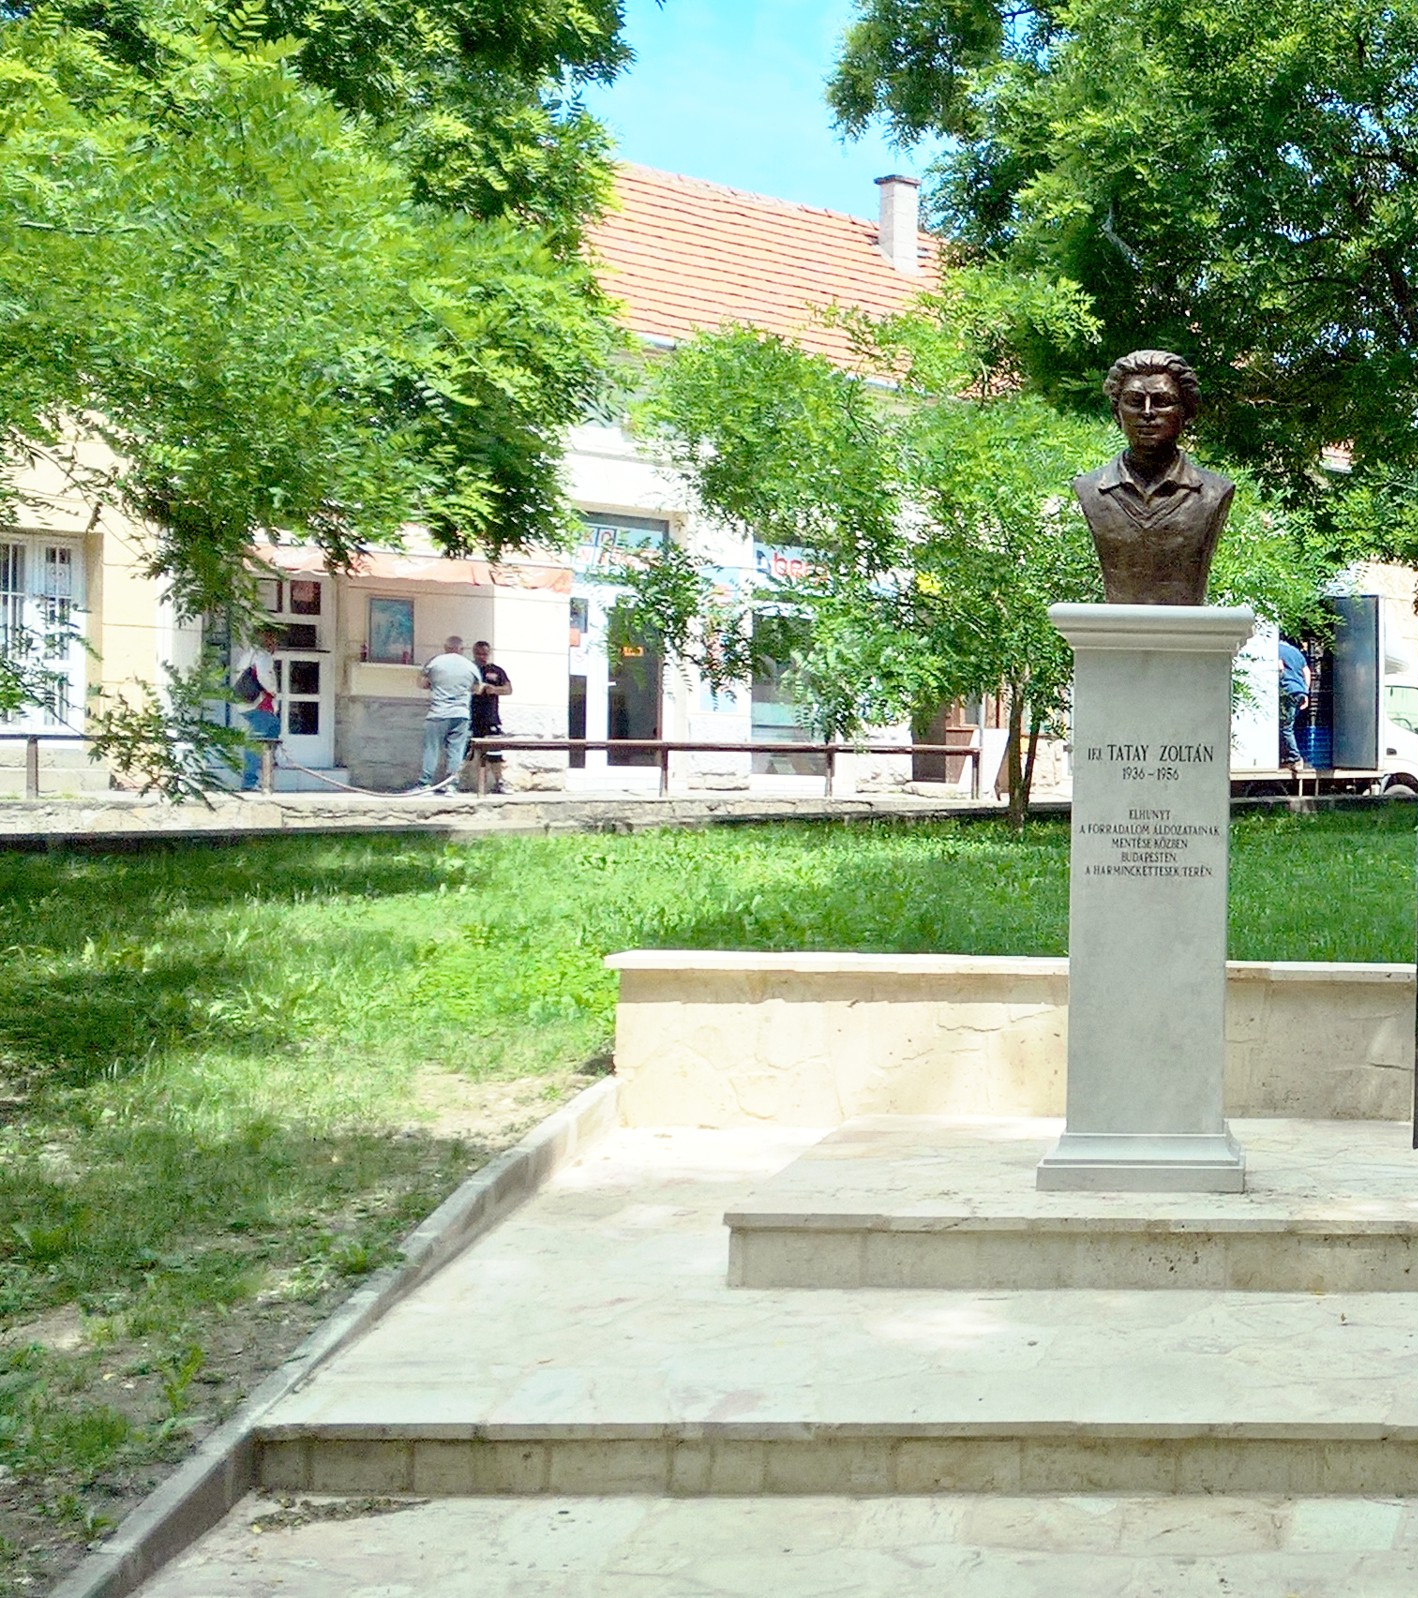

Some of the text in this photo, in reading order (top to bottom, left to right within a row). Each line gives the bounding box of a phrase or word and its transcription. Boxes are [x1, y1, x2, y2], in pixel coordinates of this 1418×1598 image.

[1107, 743, 1149, 761] TATAY
[1159, 744, 1213, 763] ZOLTÁN
[1129, 808, 1171, 820] ELHUNYT
[1079, 823, 1220, 836] A FORRADALOM ÁLDOZATAINAK
[1112, 836, 1189, 849] MENTÉSE KÖZBEN
[1121, 852, 1177, 863] BUDAPESTEN
[1085, 865, 1091, 875] A
